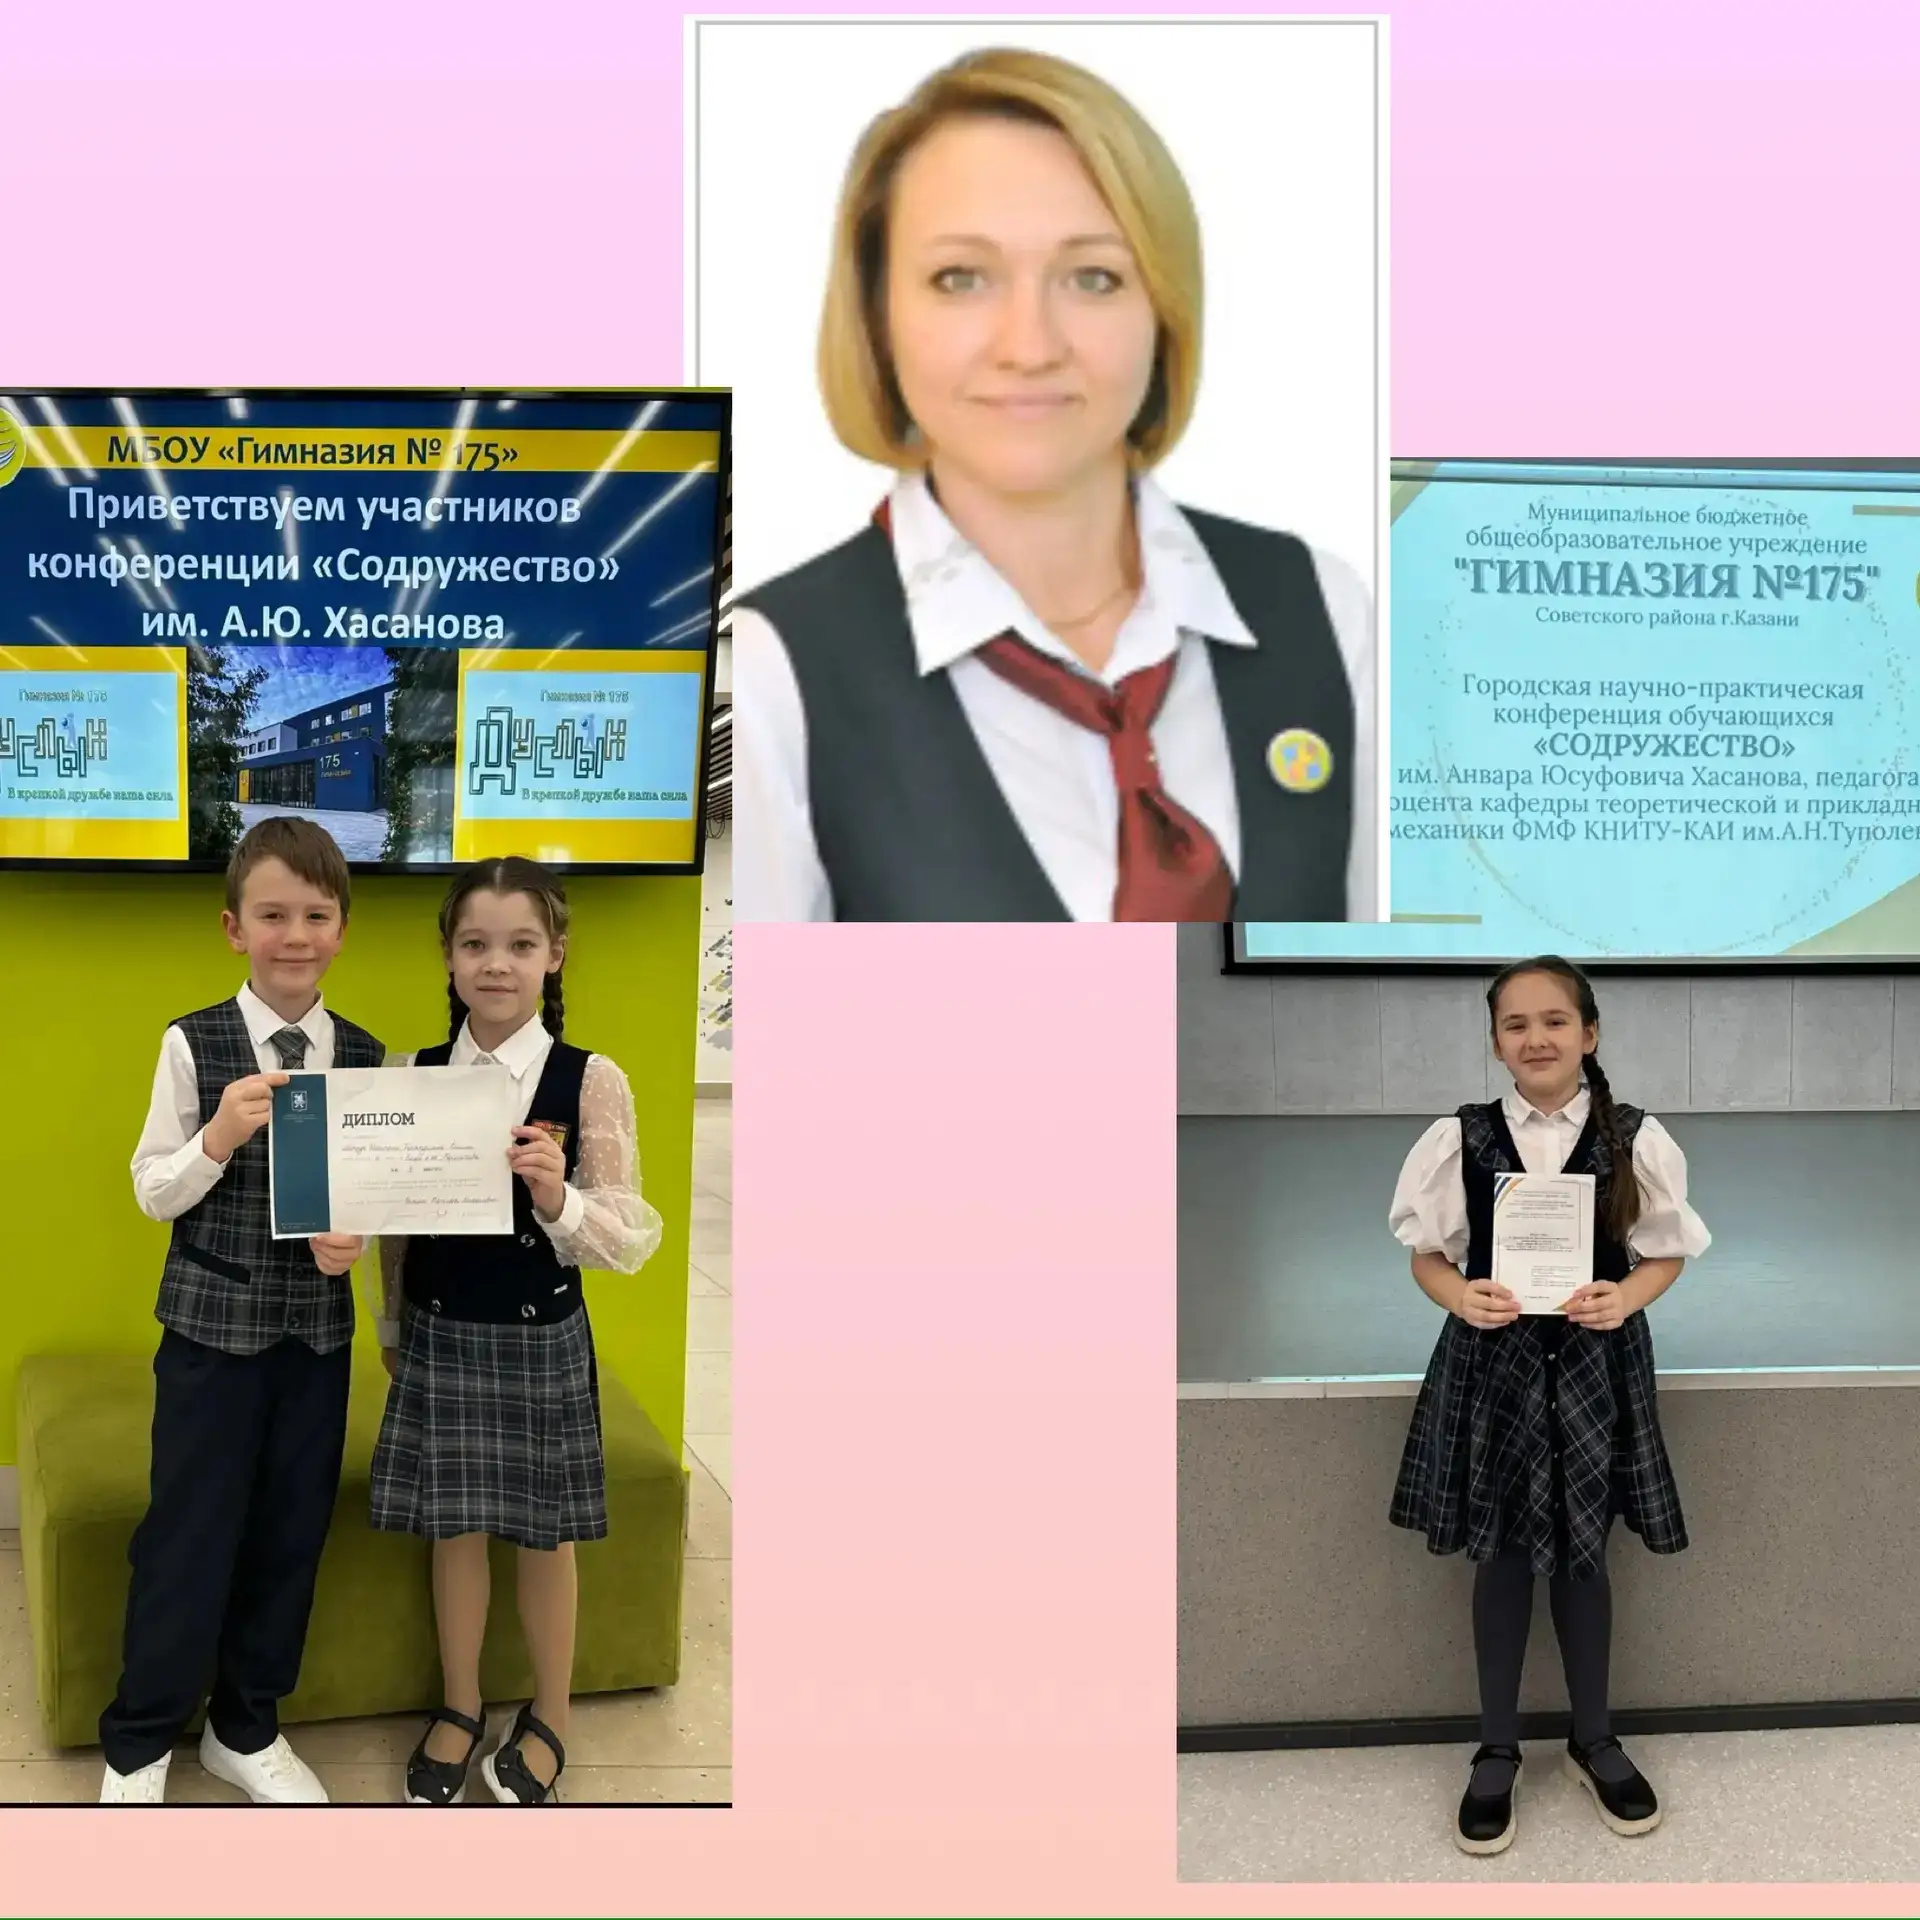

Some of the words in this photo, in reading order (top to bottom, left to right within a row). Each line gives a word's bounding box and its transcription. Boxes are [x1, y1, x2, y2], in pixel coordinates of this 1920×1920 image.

[107, 435, 210, 463] МБОУ
[218, 436, 395, 464] «Гимназия
[406, 438, 441, 464] №
[452, 443, 519, 471] 175»
[68, 486, 345, 530] Приветствуем
[356, 495, 581, 530] участников
[1527, 503, 1690, 525] Муниципальное
[1696, 504, 1808, 527] бюджетное
[1466, 525, 1722, 555] общеобразовательное
[1728, 536, 1868, 558] учреждение
[28, 546, 299, 587] конференции
[312, 548, 620, 589] «Содружество»
[1454, 556, 1741, 599] "ГИМНАЗИЯ
[1752, 563, 1881, 602] №175"
[142, 612, 208, 637] им.
[220, 606, 311, 638] А.Ю.
[323, 606, 504, 640] Хасанова
[1535, 606, 1644, 625] Советского
[1649, 611, 1716, 630] района
[1721, 609, 1799, 628] г.Казани
[1463, 673, 1591, 701] Городская
[1599, 680, 1864, 704] научно-практическая
[1493, 703, 1661, 730] конференция
[1669, 704, 1834, 731] обучающихся
[1534, 732, 1796, 761] «СОДРУЖЕСТВО»
[320, 753, 341, 769] 175
[1398, 767, 1438, 784] им.
[1446, 765, 1533, 791] Анвара
[1541, 764, 1684, 792] Юсуфовича
[1692, 766, 1808, 789] Хасанова,
[1816, 770, 1919, 791] педагога
[1480, 792, 1588, 818] кафедры
[1596, 795, 1776, 820] теоретической
[1784, 800, 1798, 813] и
[1512, 819, 1576, 841] ФМФ
[1584, 820, 1734, 841] КНИТУ-КАИ
[342, 1112, 415, 1128] ДИПЛОМ
